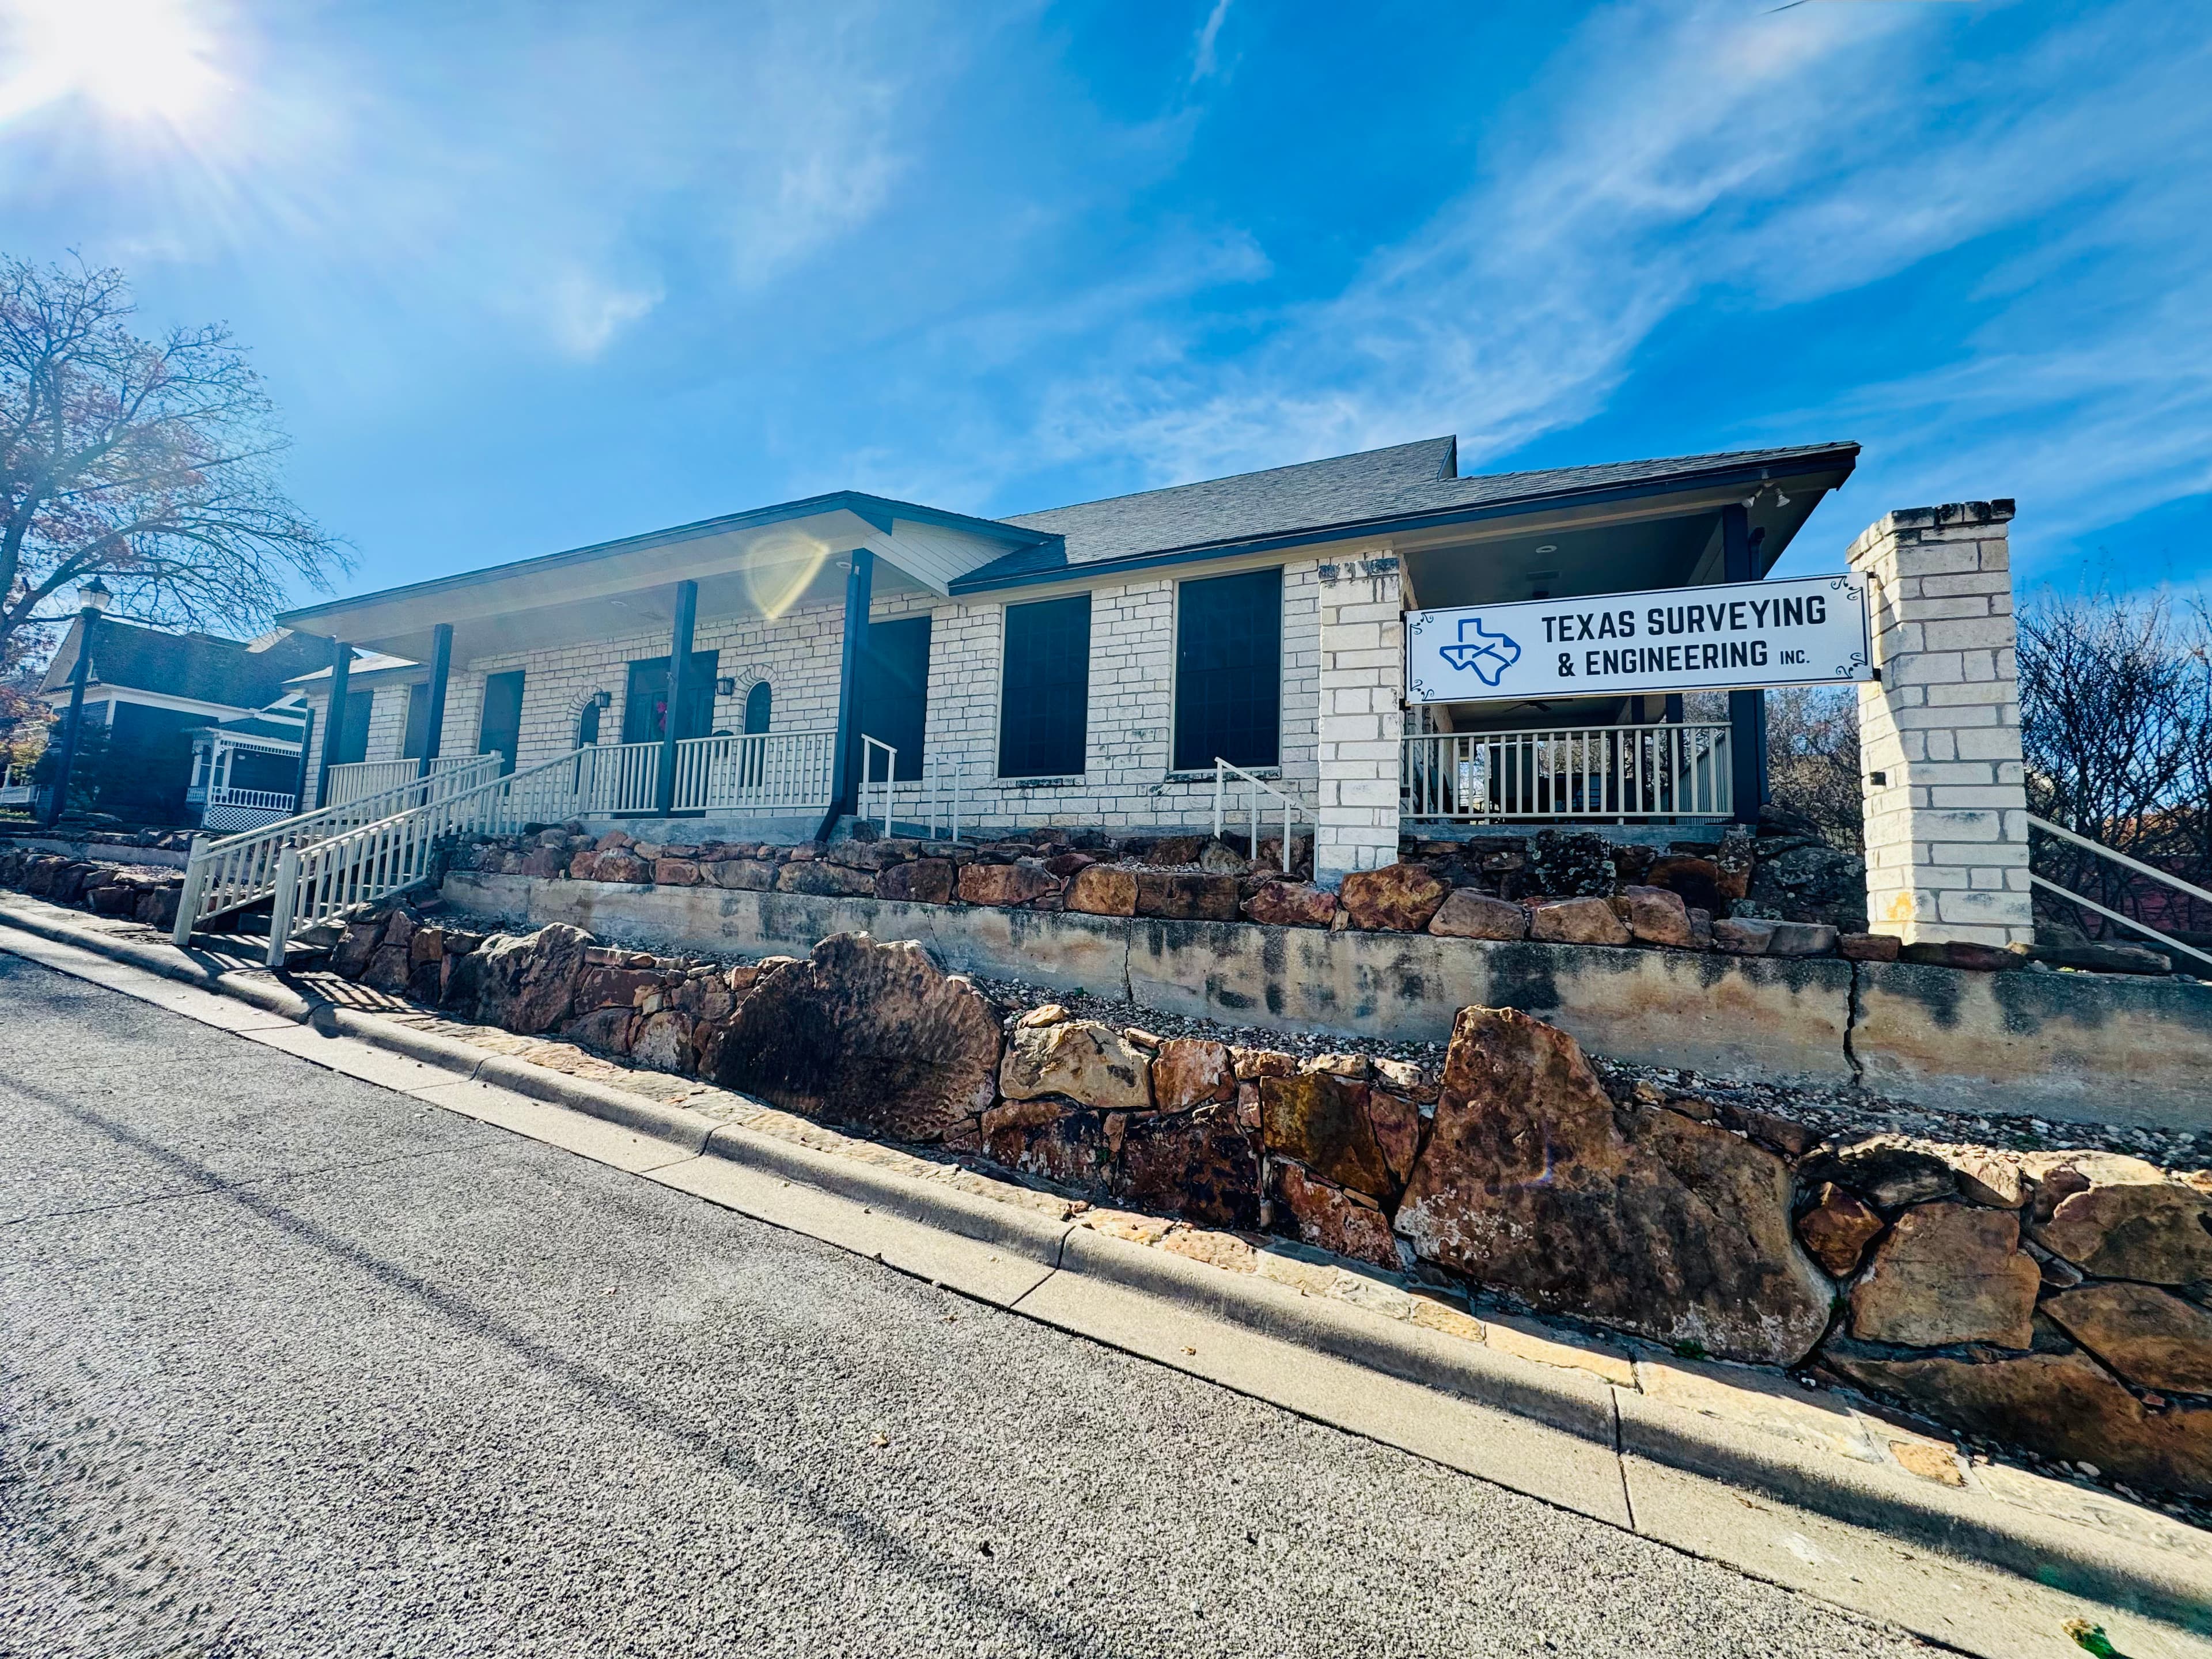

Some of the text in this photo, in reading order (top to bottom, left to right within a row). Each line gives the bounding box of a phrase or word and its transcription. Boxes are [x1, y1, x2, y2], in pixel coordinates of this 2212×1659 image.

[1541, 595, 1826, 643] TEXAS SURVEYING
[1558, 640, 1810, 678] & ENGINEERING INC.
